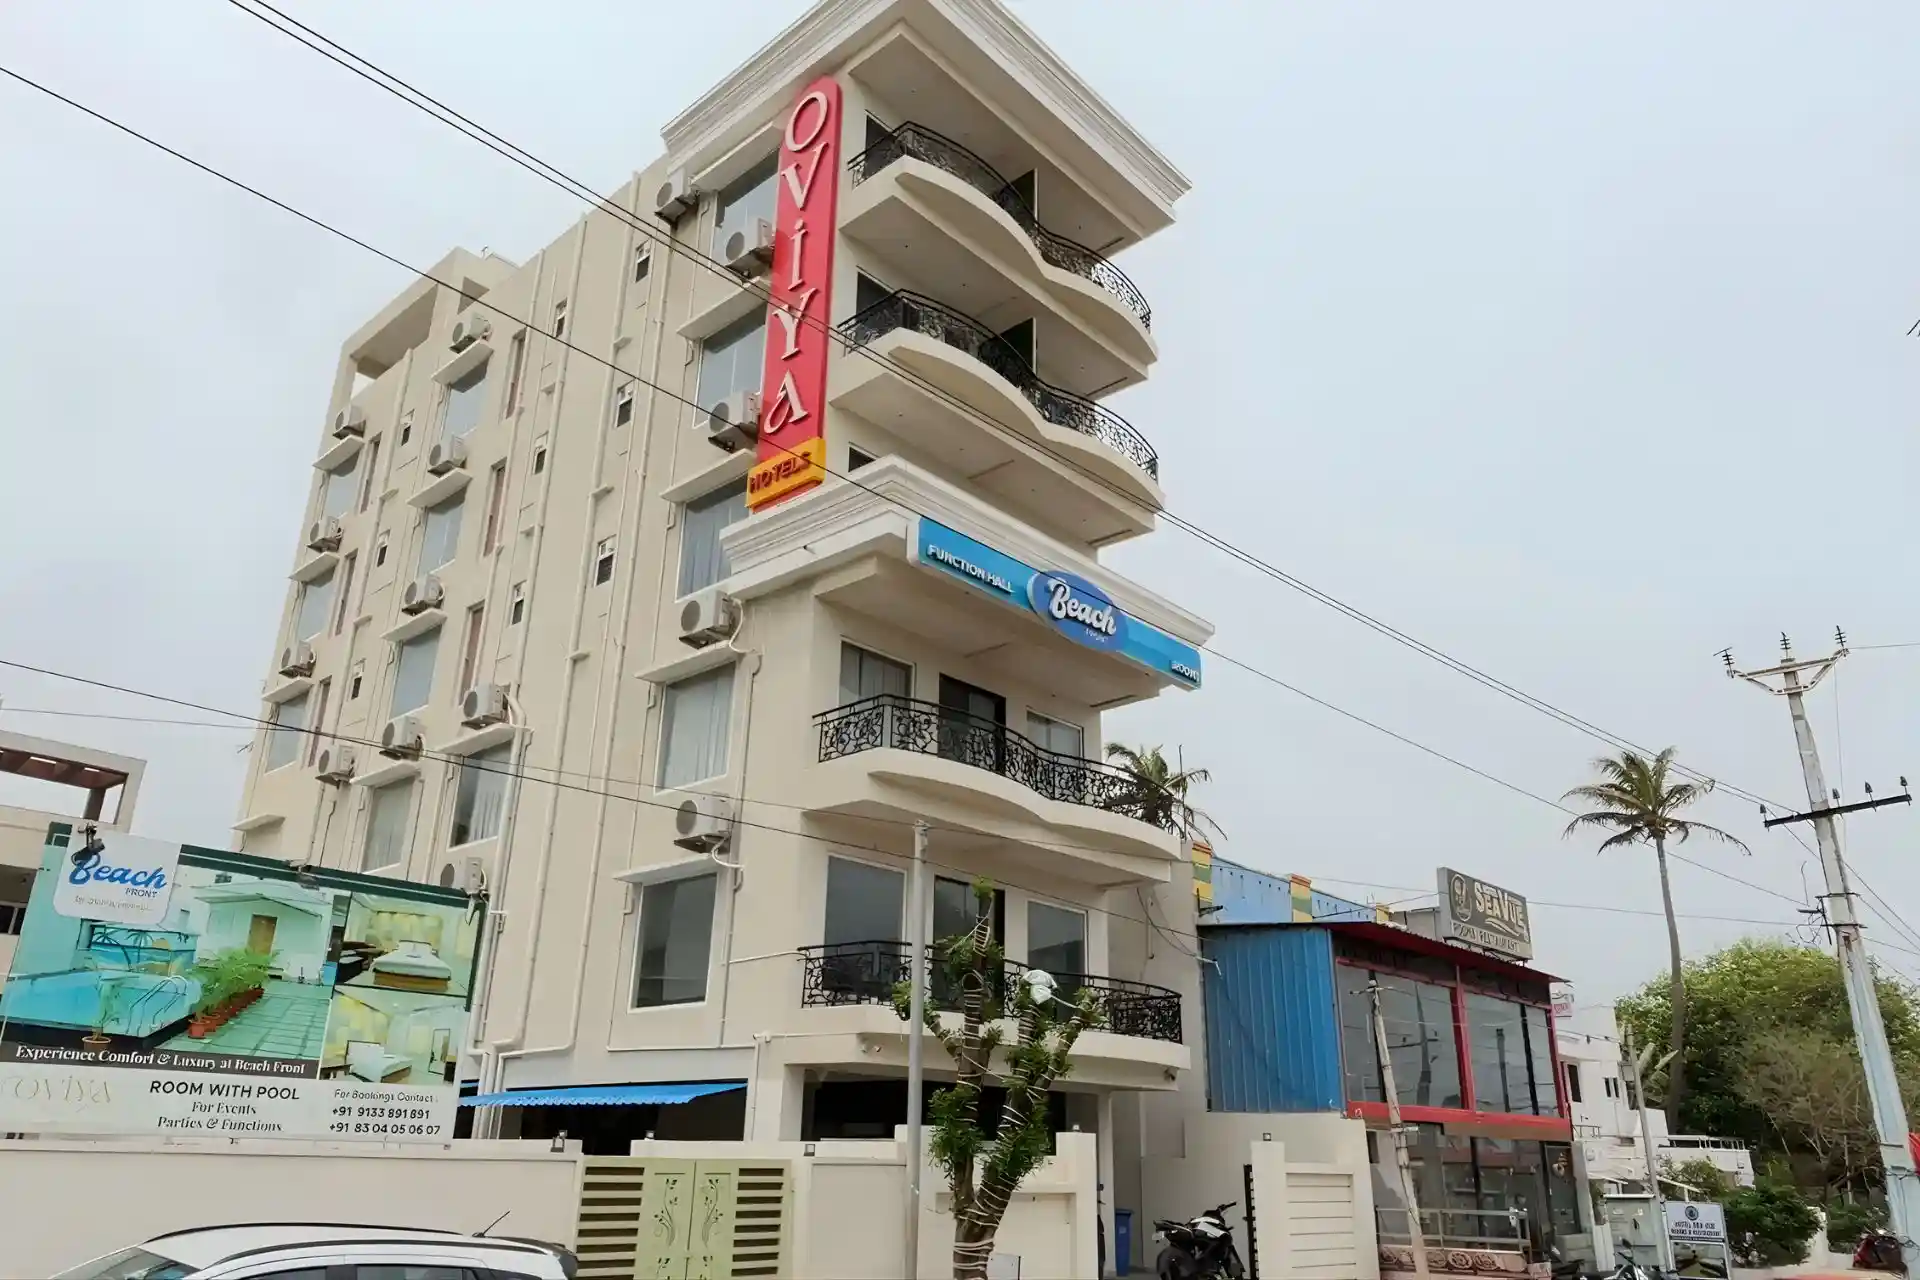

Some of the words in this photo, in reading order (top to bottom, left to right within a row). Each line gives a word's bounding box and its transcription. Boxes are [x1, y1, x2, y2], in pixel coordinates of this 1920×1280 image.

[749, 451, 812, 494] HOTELS
[927, 544, 986, 580] FUNCTION
[987, 573, 1015, 593] HALL
[1047, 577, 1117, 635] Beach
[69, 851, 167, 889] Beach
[125, 887, 158, 898] FRONT
[16, 1045, 96, 1061] Experience
[98, 1051, 155, 1065] Comfort
[157, 1053, 171, 1065] &
[173, 1054, 216, 1070] Luxury
[235, 1059, 270, 1072] Beach
[273, 1061, 305, 1074] Front
[150, 1080, 204, 1096] ROOM
[209, 1083, 252, 1098] WITH
[257, 1086, 300, 1100] POOL
[334, 1089, 349, 1098] For
[192, 1101, 214, 1113] For
[332, 1106, 352, 1117] +91
[158, 1117, 203, 1129] Parties
[206, 1118, 219, 1129] &
[221, 1119, 283, 1132] Functions
[329, 1122, 349, 1133] +91
